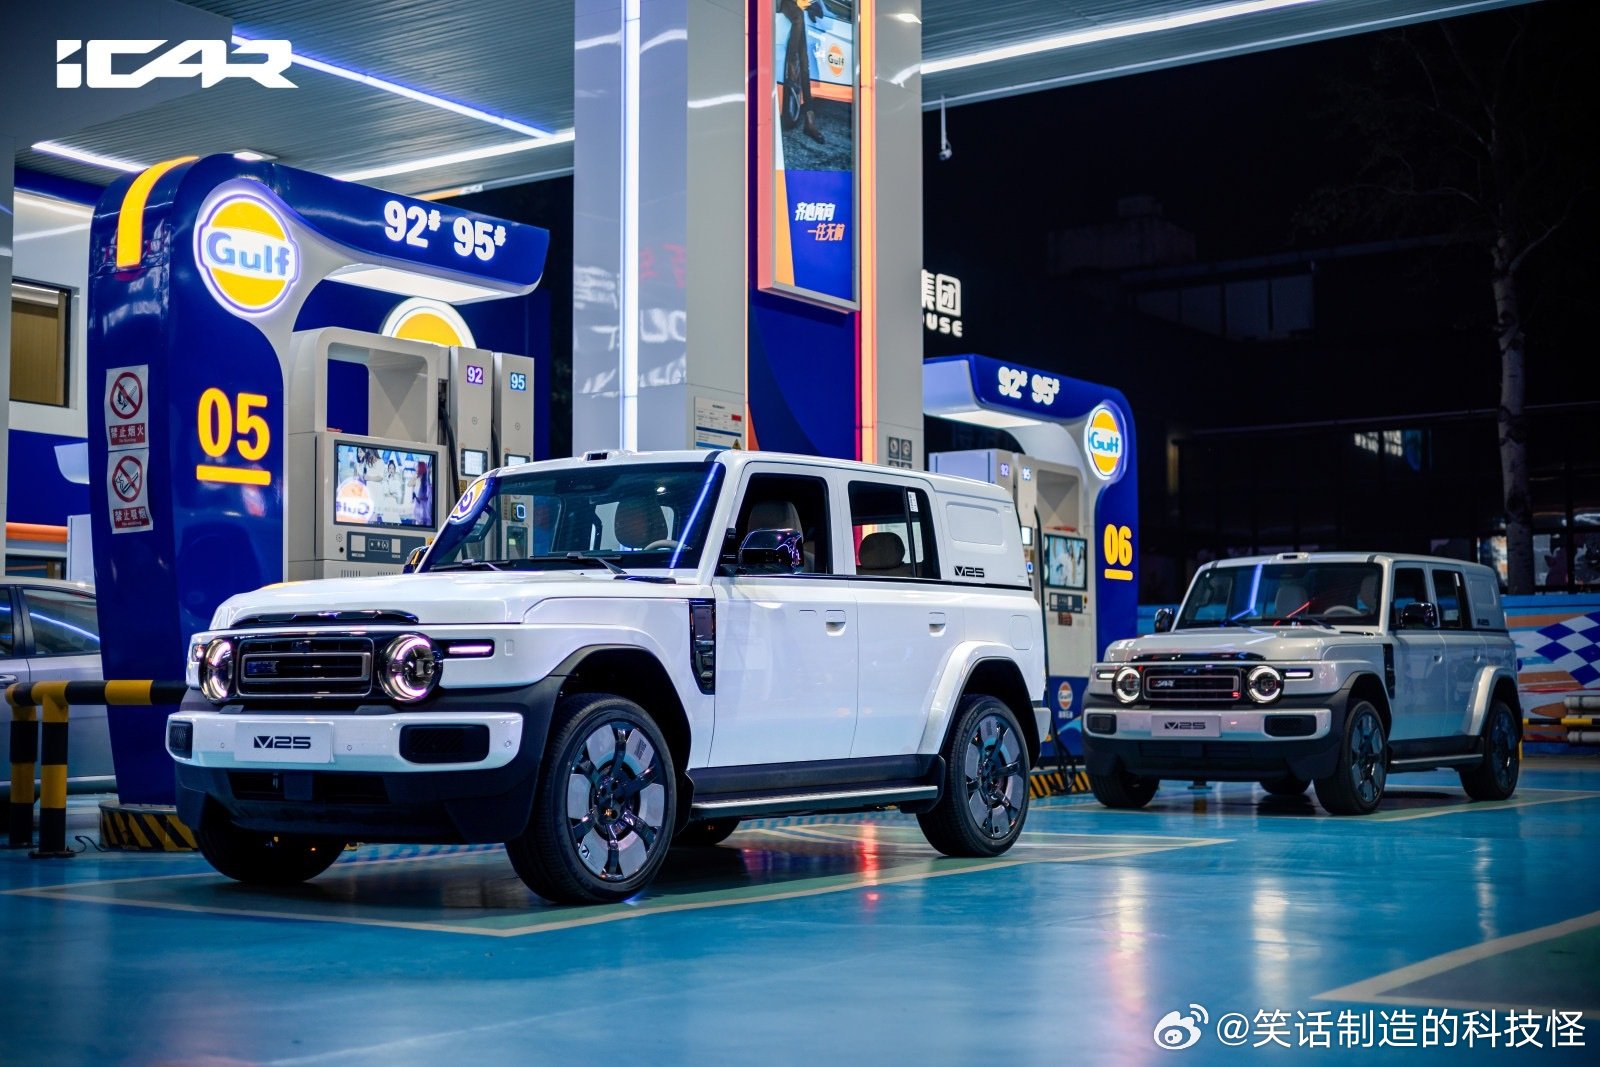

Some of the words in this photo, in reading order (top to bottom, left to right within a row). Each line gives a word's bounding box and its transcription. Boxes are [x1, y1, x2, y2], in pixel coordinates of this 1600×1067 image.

[827, 54, 844, 66] Gulf
[206, 231, 290, 276] Gulf
[922, 312, 963, 337] USE
[467, 366, 483, 384] 92
[511, 373, 525, 390] 95
[110, 424, 144, 439] 禁止烟火
[197, 387, 270, 461] 05
[1089, 431, 1119, 454] Gulf
[1103, 523, 1133, 567] 06
[954, 565, 985, 578] V25
[1164, 721, 1206, 730] V25
[253, 735, 312, 750] V25
